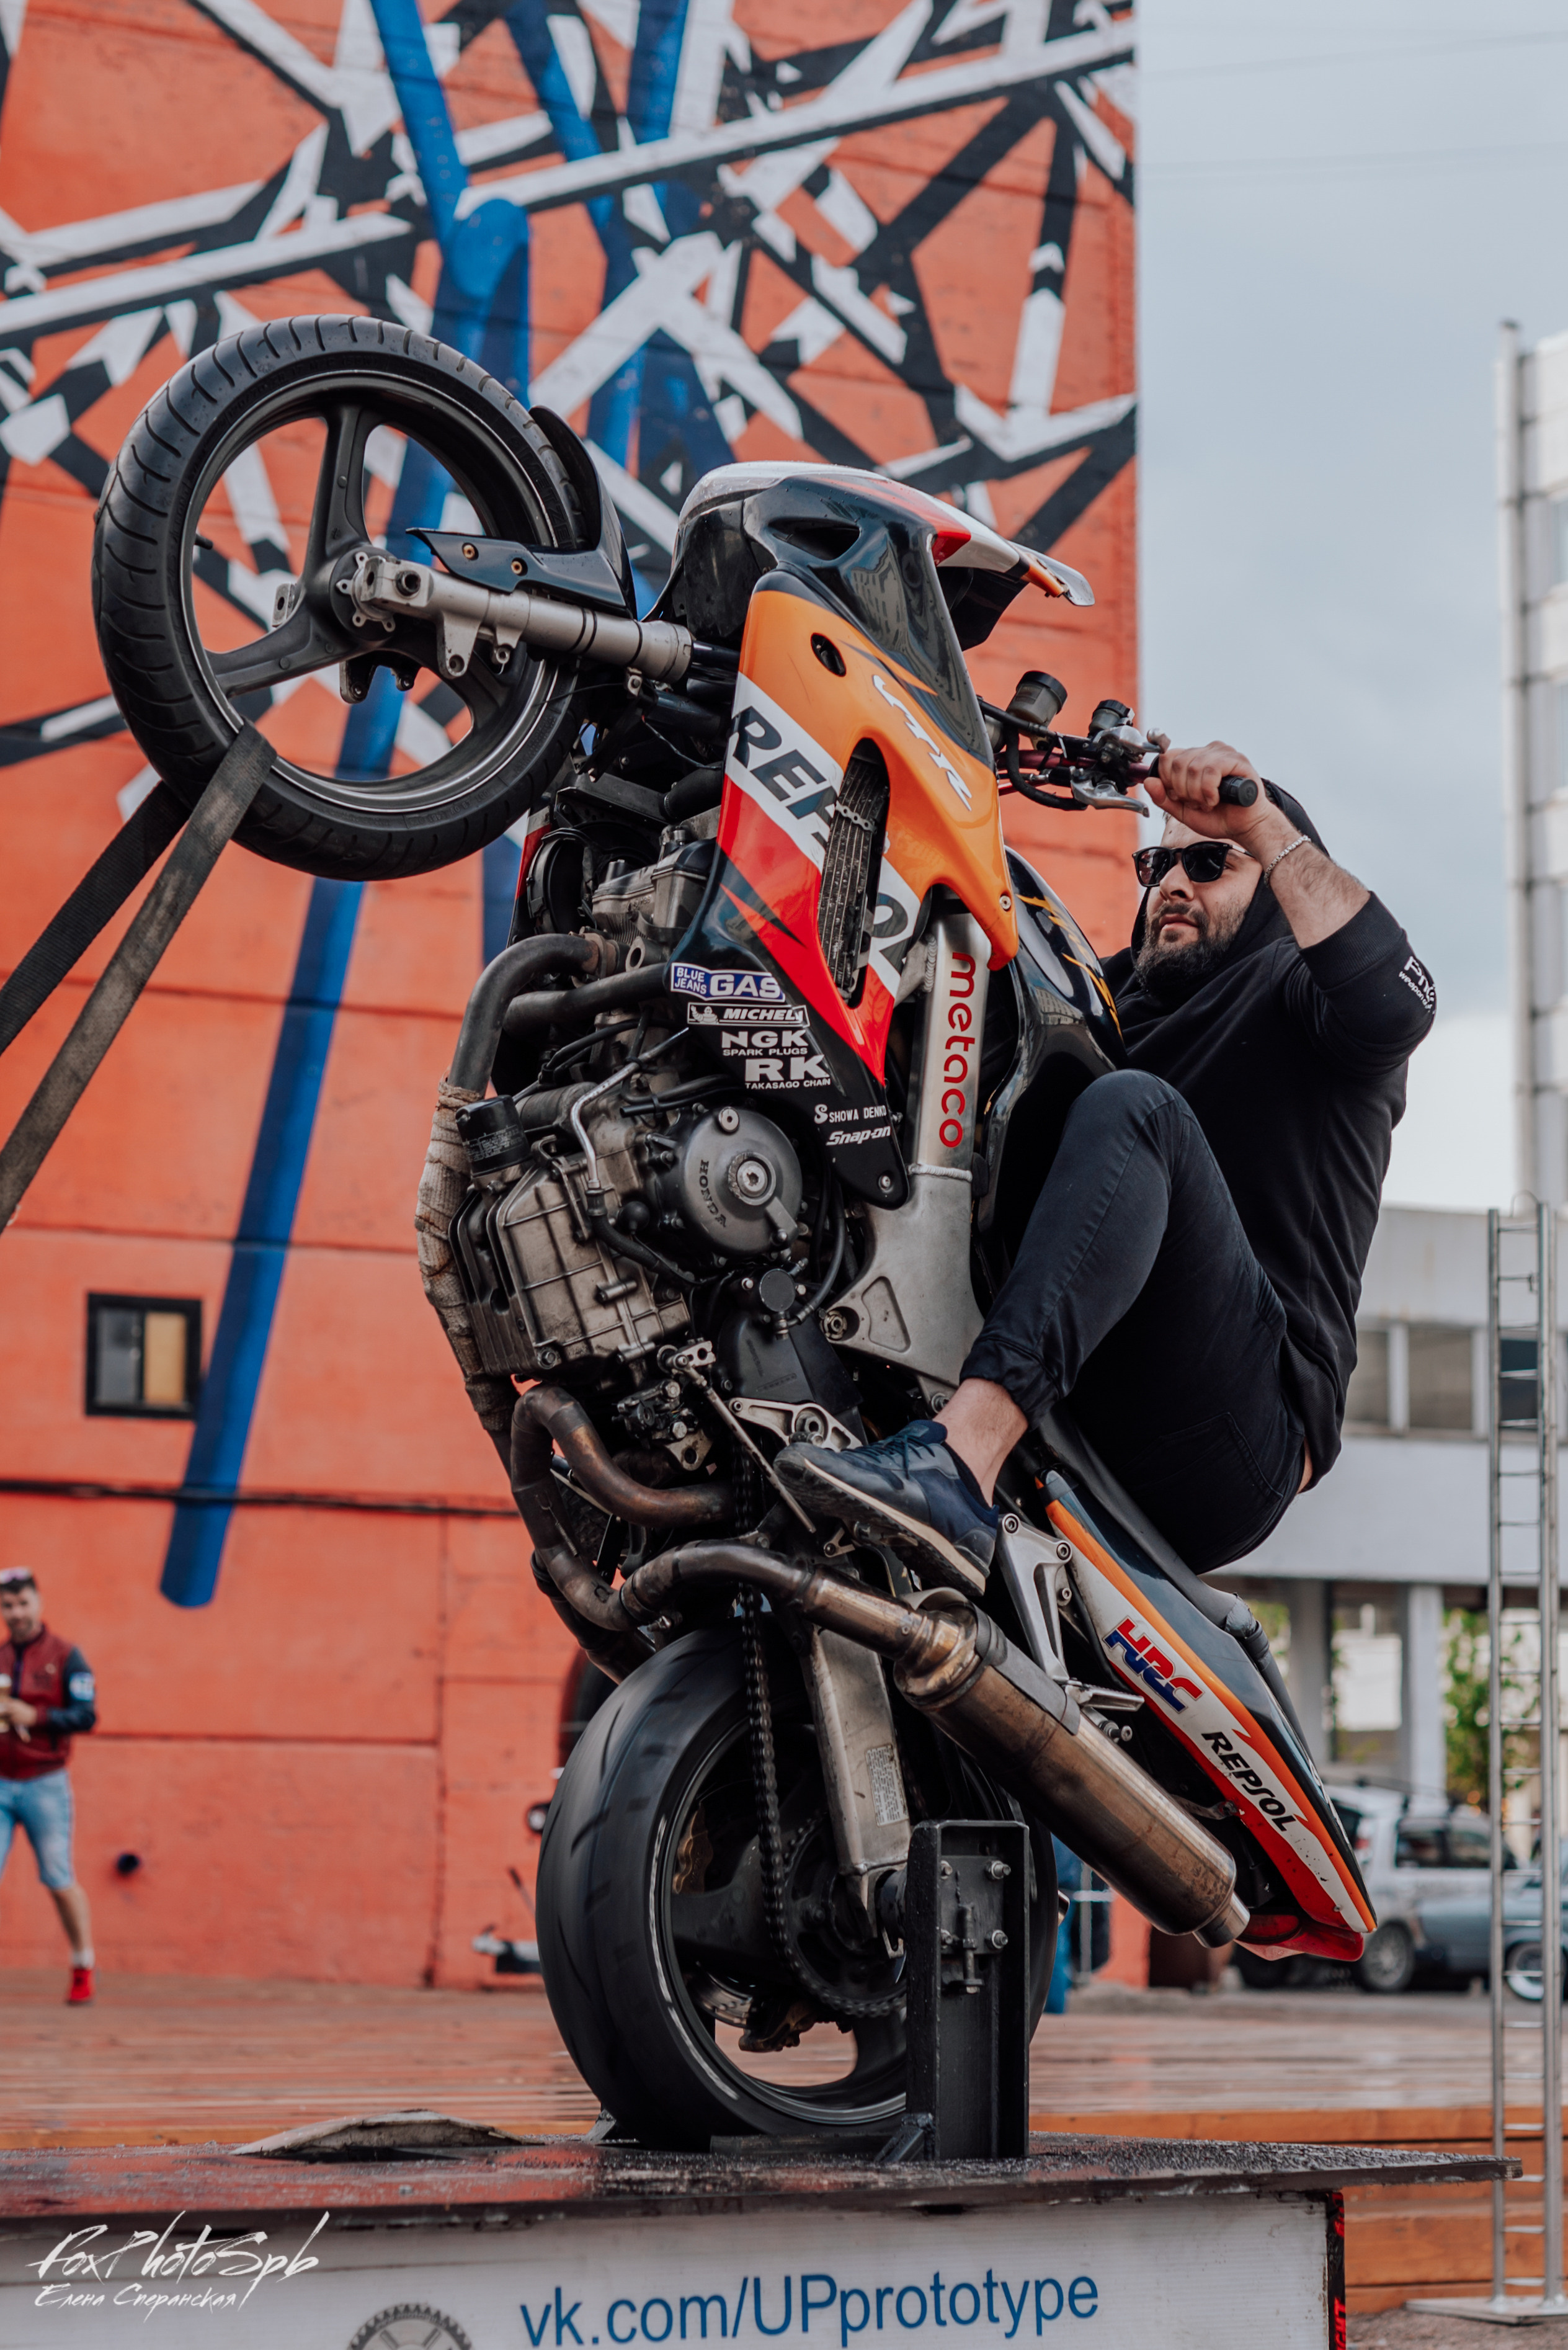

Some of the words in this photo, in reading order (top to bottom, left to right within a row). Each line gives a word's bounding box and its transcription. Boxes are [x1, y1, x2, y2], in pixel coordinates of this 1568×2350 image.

[519, 448, 572, 548] METZE
[731, 705, 913, 975] REPOL
[674, 978, 707, 995] JEANS
[676, 967, 705, 983] BLUE
[709, 973, 782, 999] GAS
[723, 1007, 804, 1022] MICHELN
[721, 1029, 808, 1048] NGK
[939, 952, 976, 1148] metaco
[723, 1048, 764, 1057] SPARK
[768, 1047, 808, 1056] PLUGS
[745, 1054, 830, 1082] RK
[746, 1080, 800, 1090] TAKASAGO
[803, 1078, 831, 1087] CHAIN
[829, 1109, 859, 1124] SHOWA
[826, 1125, 891, 1146] Snap-on
[698, 1159, 728, 1228] HONDA
[1103, 1615, 1205, 1715] HRC
[1201, 1731, 1298, 1832] REPSOL
[520, 2268, 1099, 2349] vk.com/UPprototype
